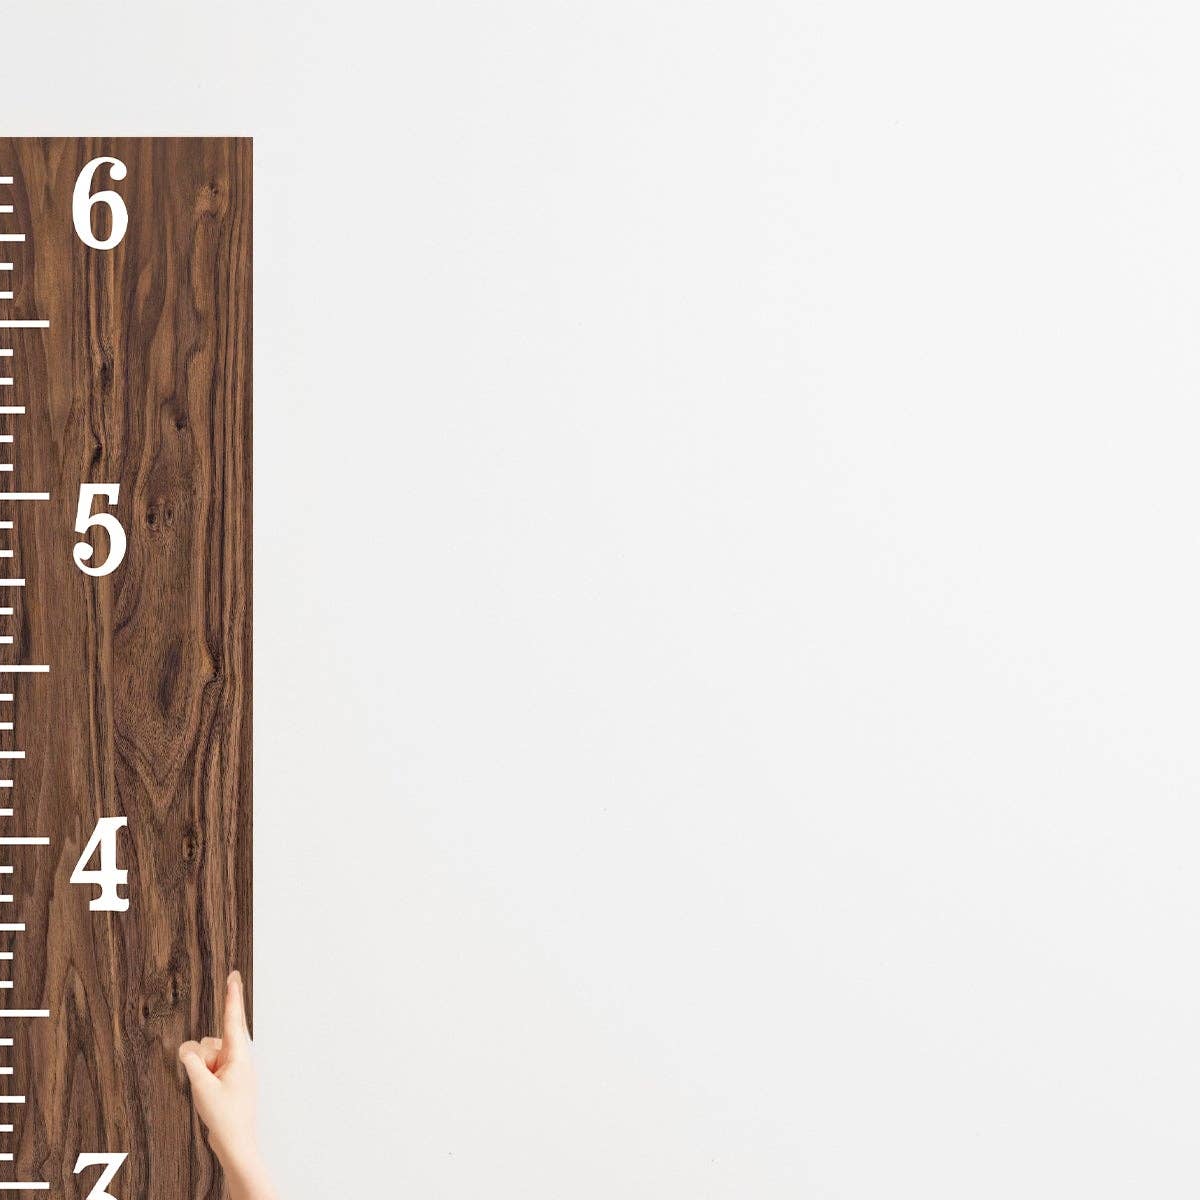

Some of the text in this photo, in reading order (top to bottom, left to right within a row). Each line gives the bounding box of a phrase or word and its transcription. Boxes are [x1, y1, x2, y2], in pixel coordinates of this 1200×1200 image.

[72, 156, 129, 250] 6
[72, 483, 127, 577] 5
[69, 816, 130, 912] 4
